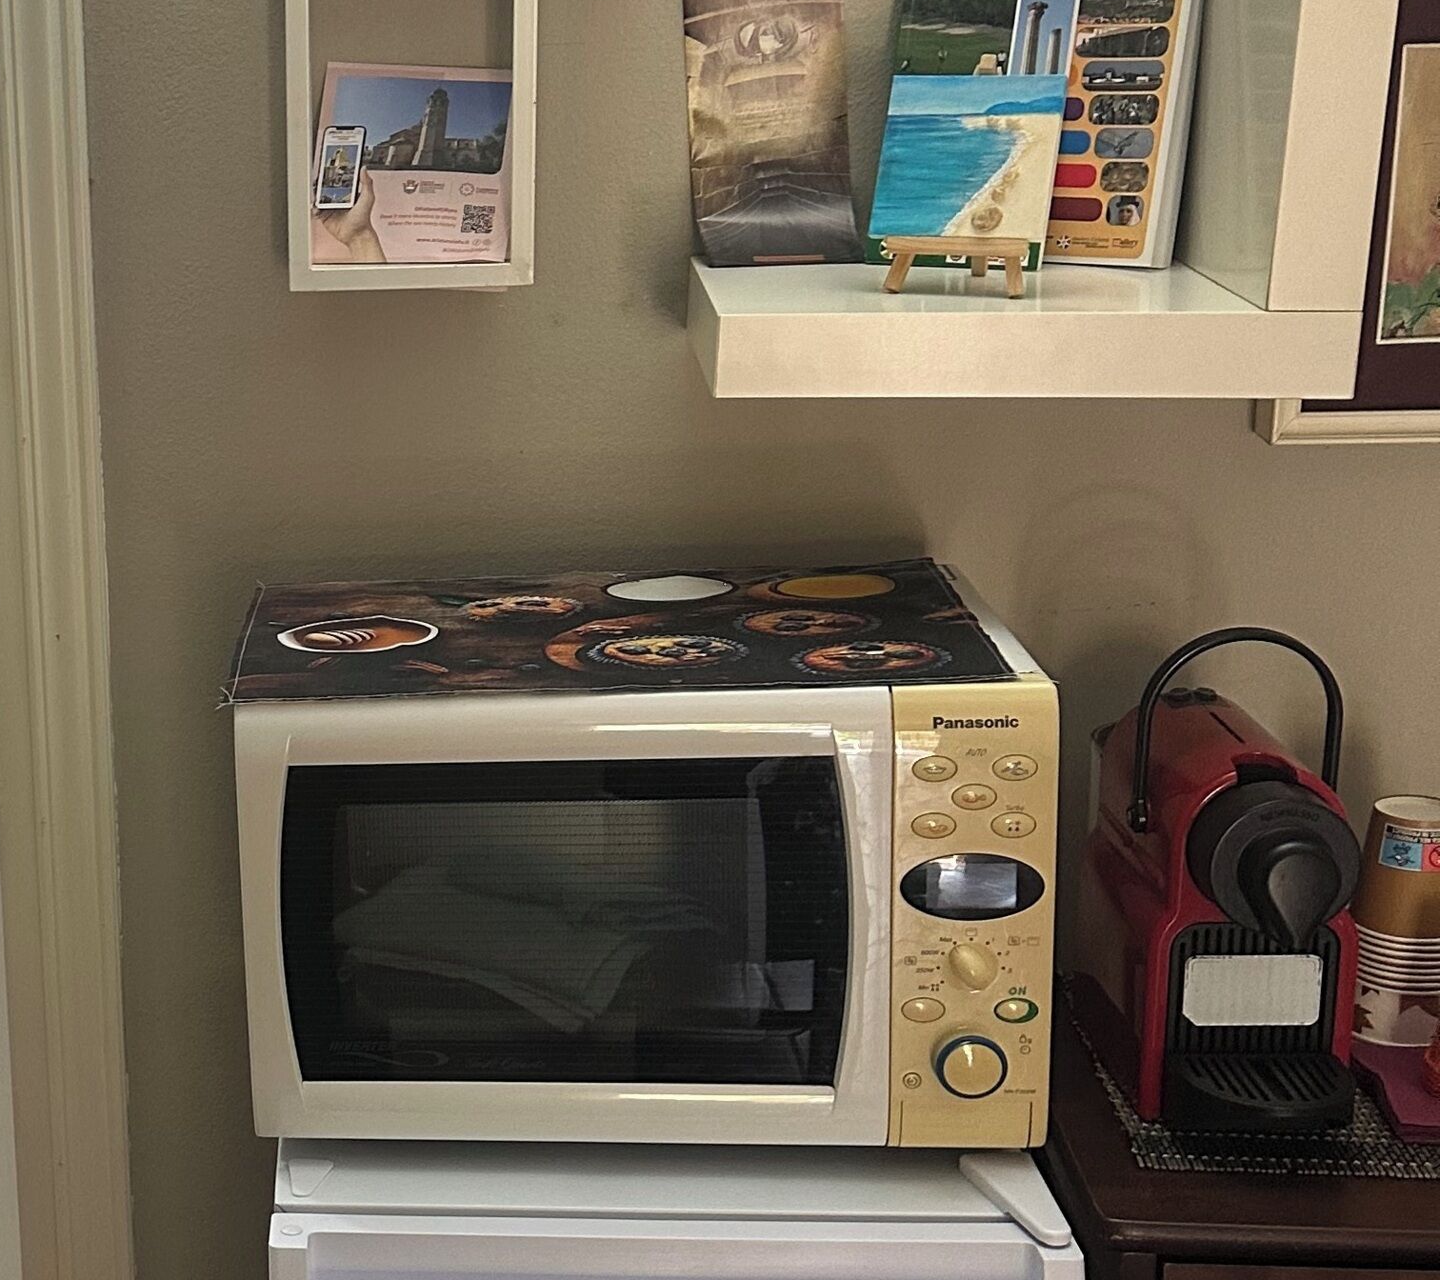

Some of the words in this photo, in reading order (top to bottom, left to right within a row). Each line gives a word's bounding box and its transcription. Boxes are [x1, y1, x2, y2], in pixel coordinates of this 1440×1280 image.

[932, 714, 1020, 729] Panasonic
[965, 747, 988, 757] AUTO
[1008, 986, 1027, 996] ON
